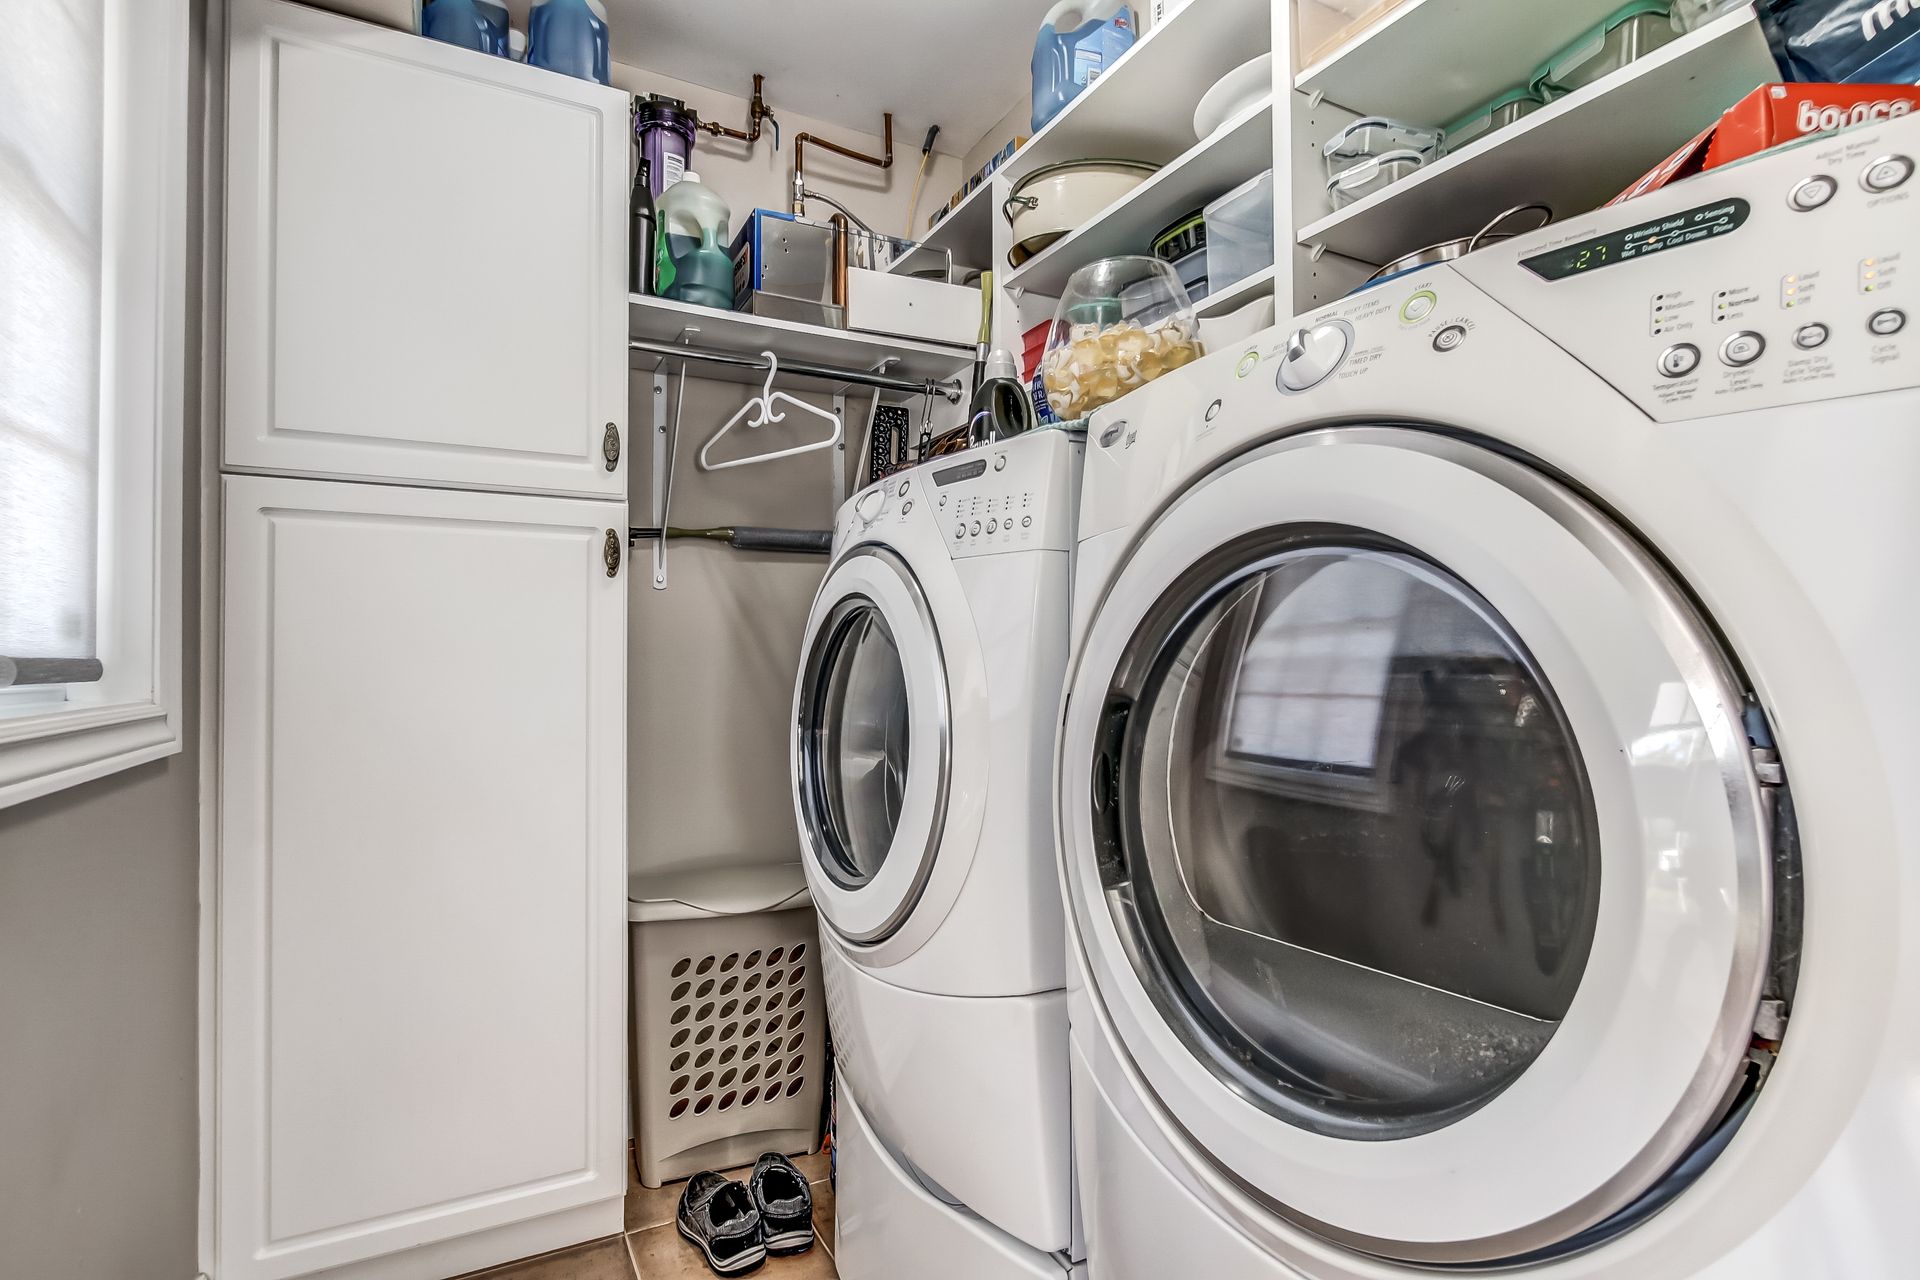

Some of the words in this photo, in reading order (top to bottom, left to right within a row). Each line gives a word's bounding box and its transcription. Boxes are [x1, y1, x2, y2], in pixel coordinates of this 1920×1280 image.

[1705, 205, 1736, 219] Sensing
[1634, 226, 1661, 239] Wrinkle
[1662, 217, 1685, 231] Shield
[1621, 248, 1636, 258] Wet
[1642, 242, 1664, 253] Damp
[1666, 234, 1684, 246] Cool
[1685, 229, 1708, 240] Down
[1713, 223, 1735, 234] Done
[1576, 245, 1606, 268] 27
[1728, 295, 1760, 307] Normal
[1315, 311, 1338, 323] NORMAL
[1369, 353, 1383, 362] DRY
